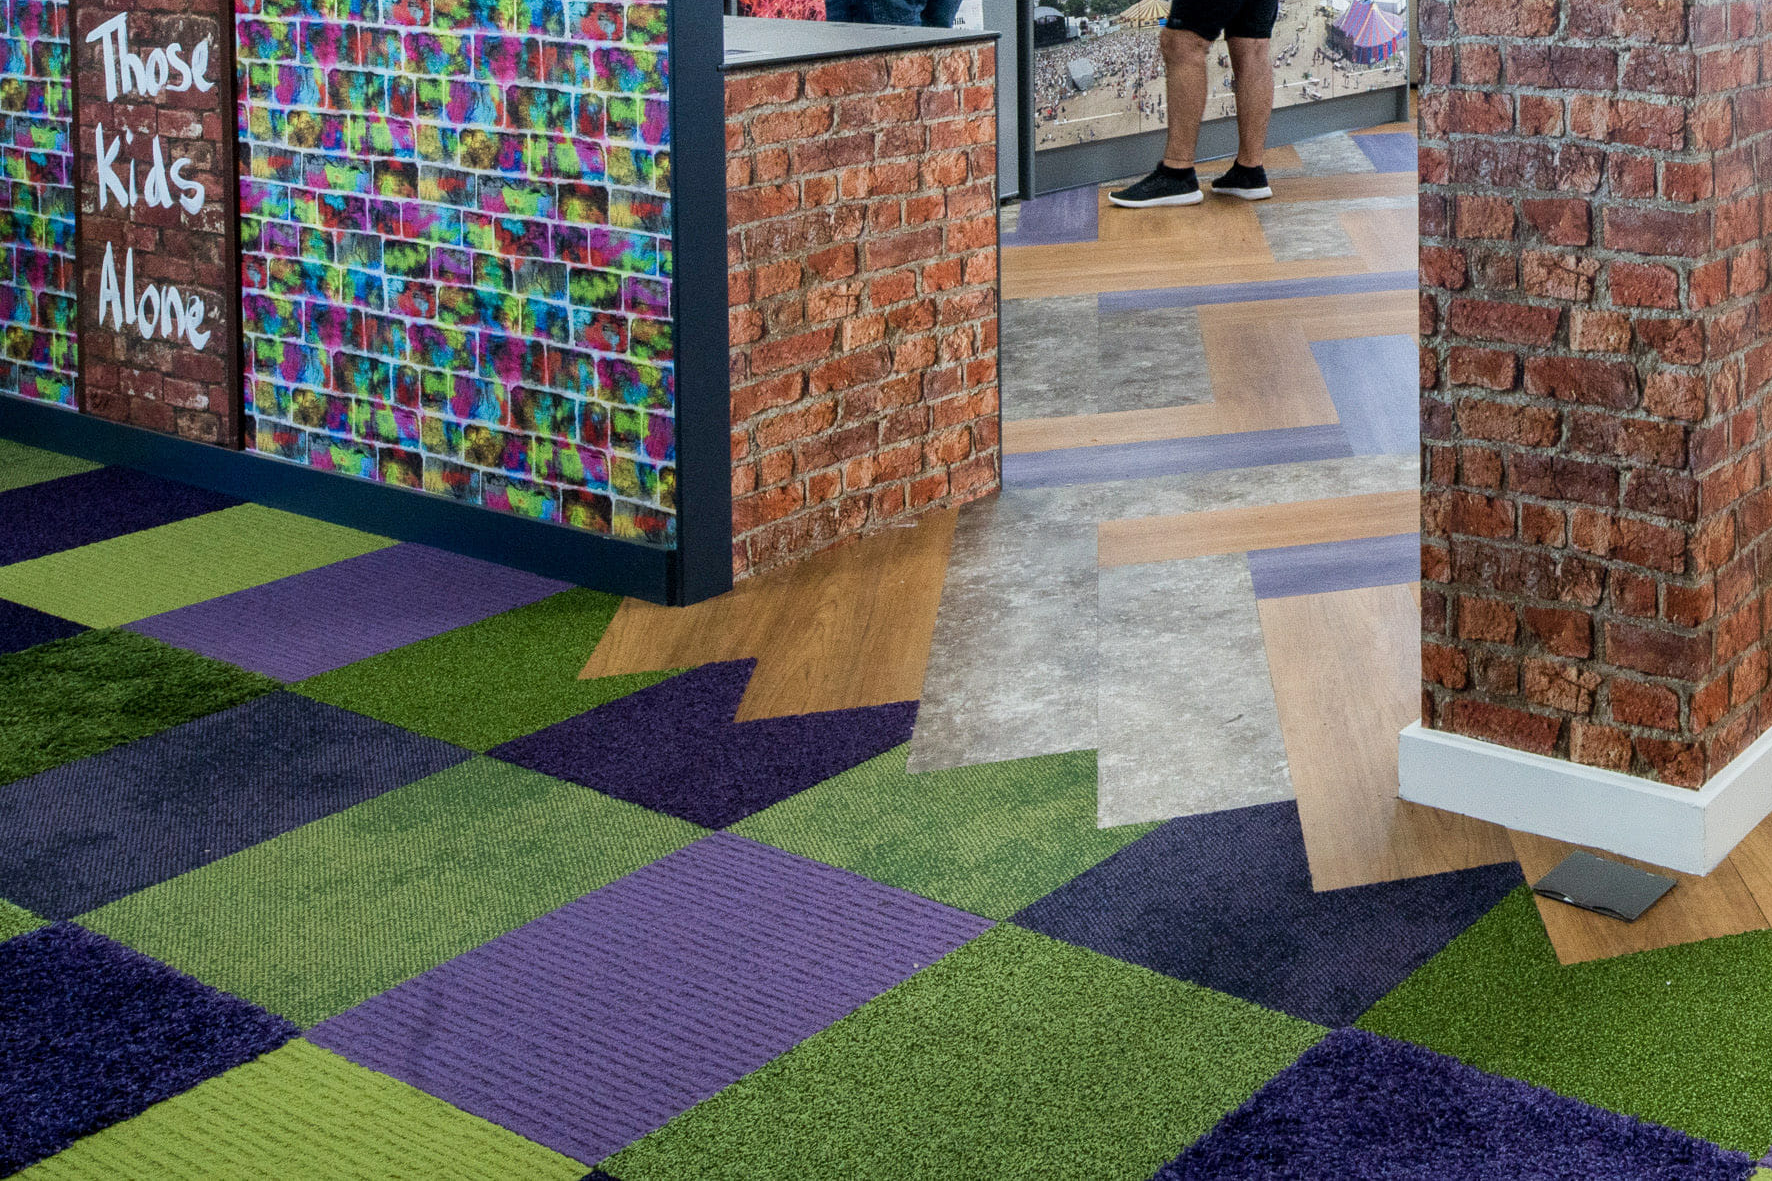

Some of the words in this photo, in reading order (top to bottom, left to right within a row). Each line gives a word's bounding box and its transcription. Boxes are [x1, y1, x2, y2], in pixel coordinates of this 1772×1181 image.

[86, 11, 215, 102] Those
[95, 122, 206, 215] Kids
[99, 241, 211, 351] Alone
